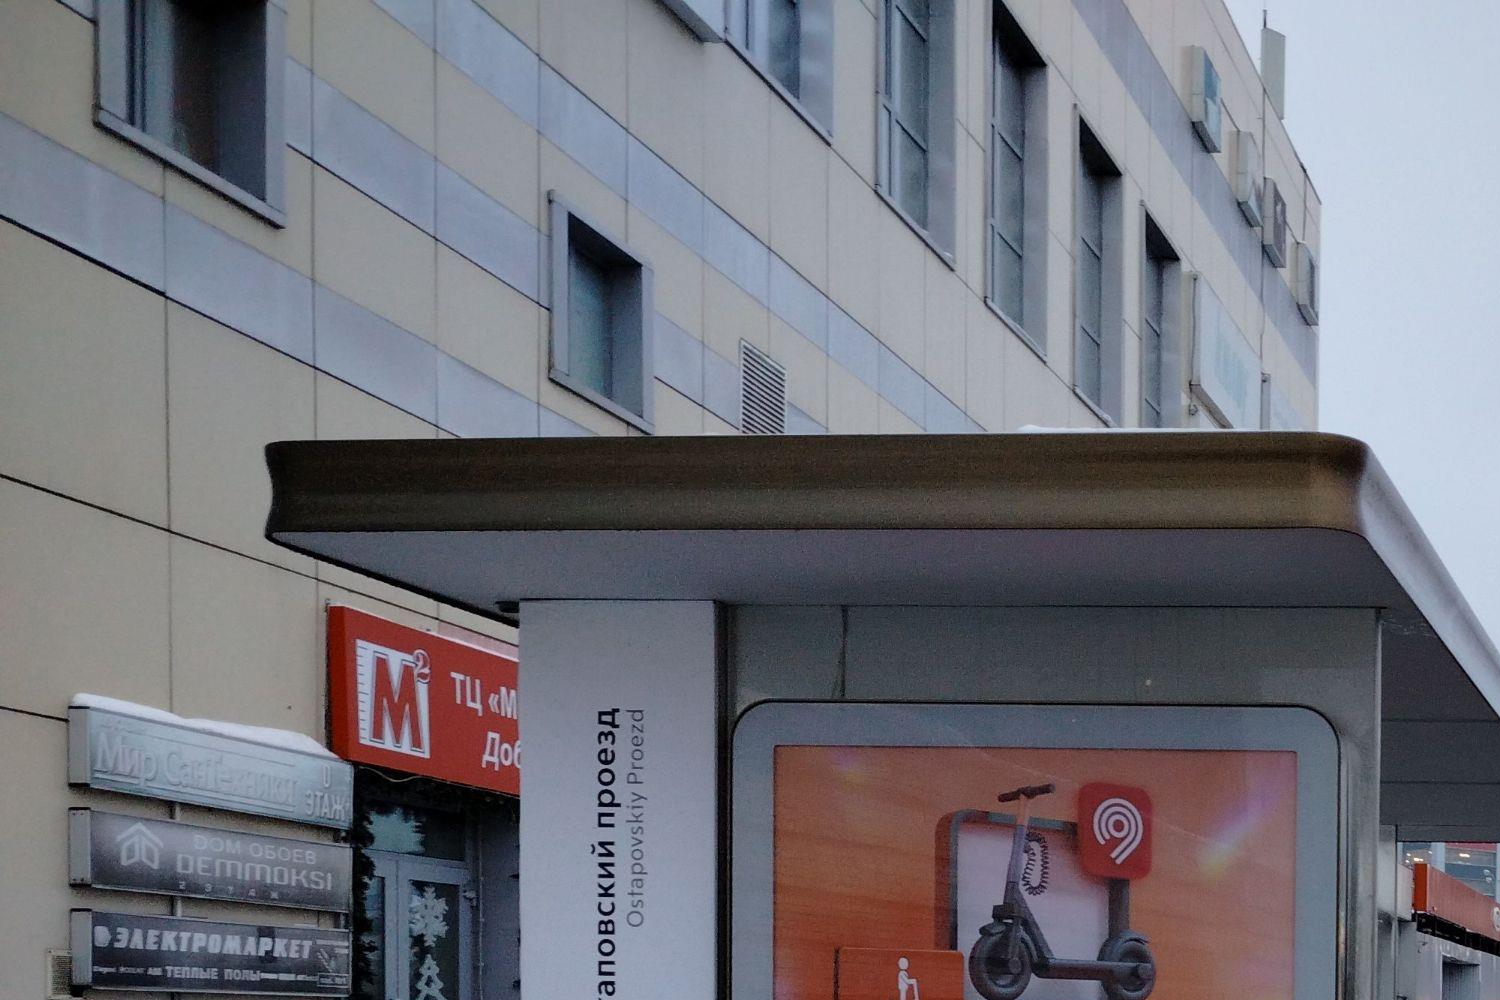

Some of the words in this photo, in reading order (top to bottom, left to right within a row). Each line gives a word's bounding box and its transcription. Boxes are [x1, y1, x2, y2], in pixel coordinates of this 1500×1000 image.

[450, 671, 483, 717] ТЦ
[96, 733, 158, 786] Мир
[597, 707, 621, 829] проезд
[626, 708, 645, 785] Proezd
[304, 790, 347, 821] ЭТАЖ
[249, 842, 317, 865] ОБОЕВ
[626, 791, 648, 928] Ostapovskiy
[113, 927, 313, 959] ЭЛЕКТРОМАРКЕТ
[165, 965, 218, 980] ТЕПЛЫЕ
[224, 968, 261, 982] ПОЛЫ
